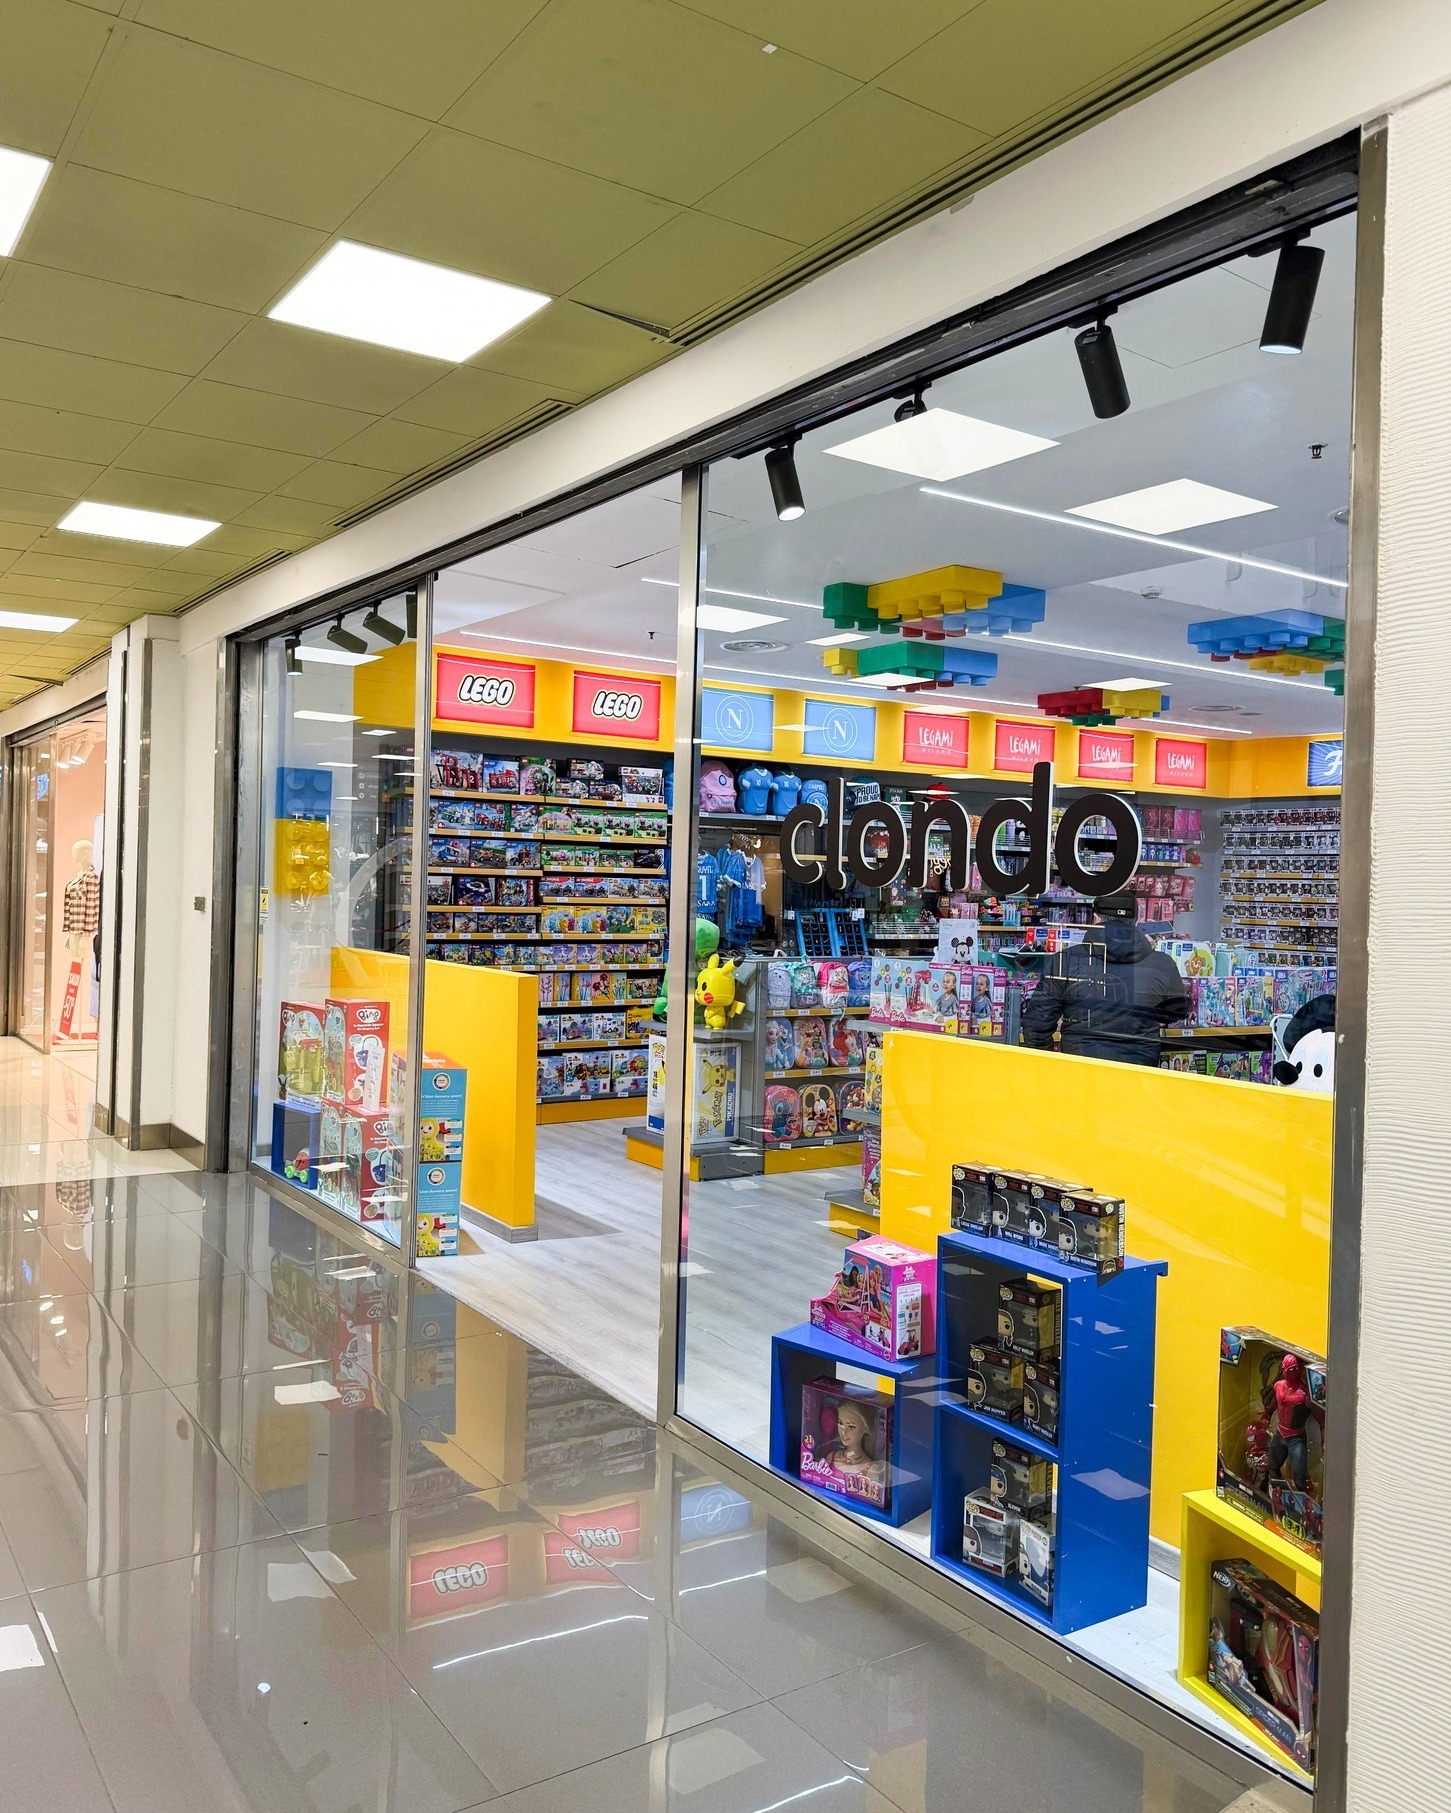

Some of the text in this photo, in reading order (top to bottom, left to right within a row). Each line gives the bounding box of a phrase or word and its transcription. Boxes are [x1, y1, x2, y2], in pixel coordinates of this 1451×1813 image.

[459, 674, 515, 706] LEGO
[592, 690, 642, 720] LEGO
[726, 707, 744, 730] N
[832, 719, 849, 741] N
[856, 783, 880, 797] PROUD
[780, 761, 1143, 897] clondo
[357, 1009, 380, 1022] Bing
[801, 1452, 834, 1476] Barbie
[1212, 1570, 1232, 1588] NERF
